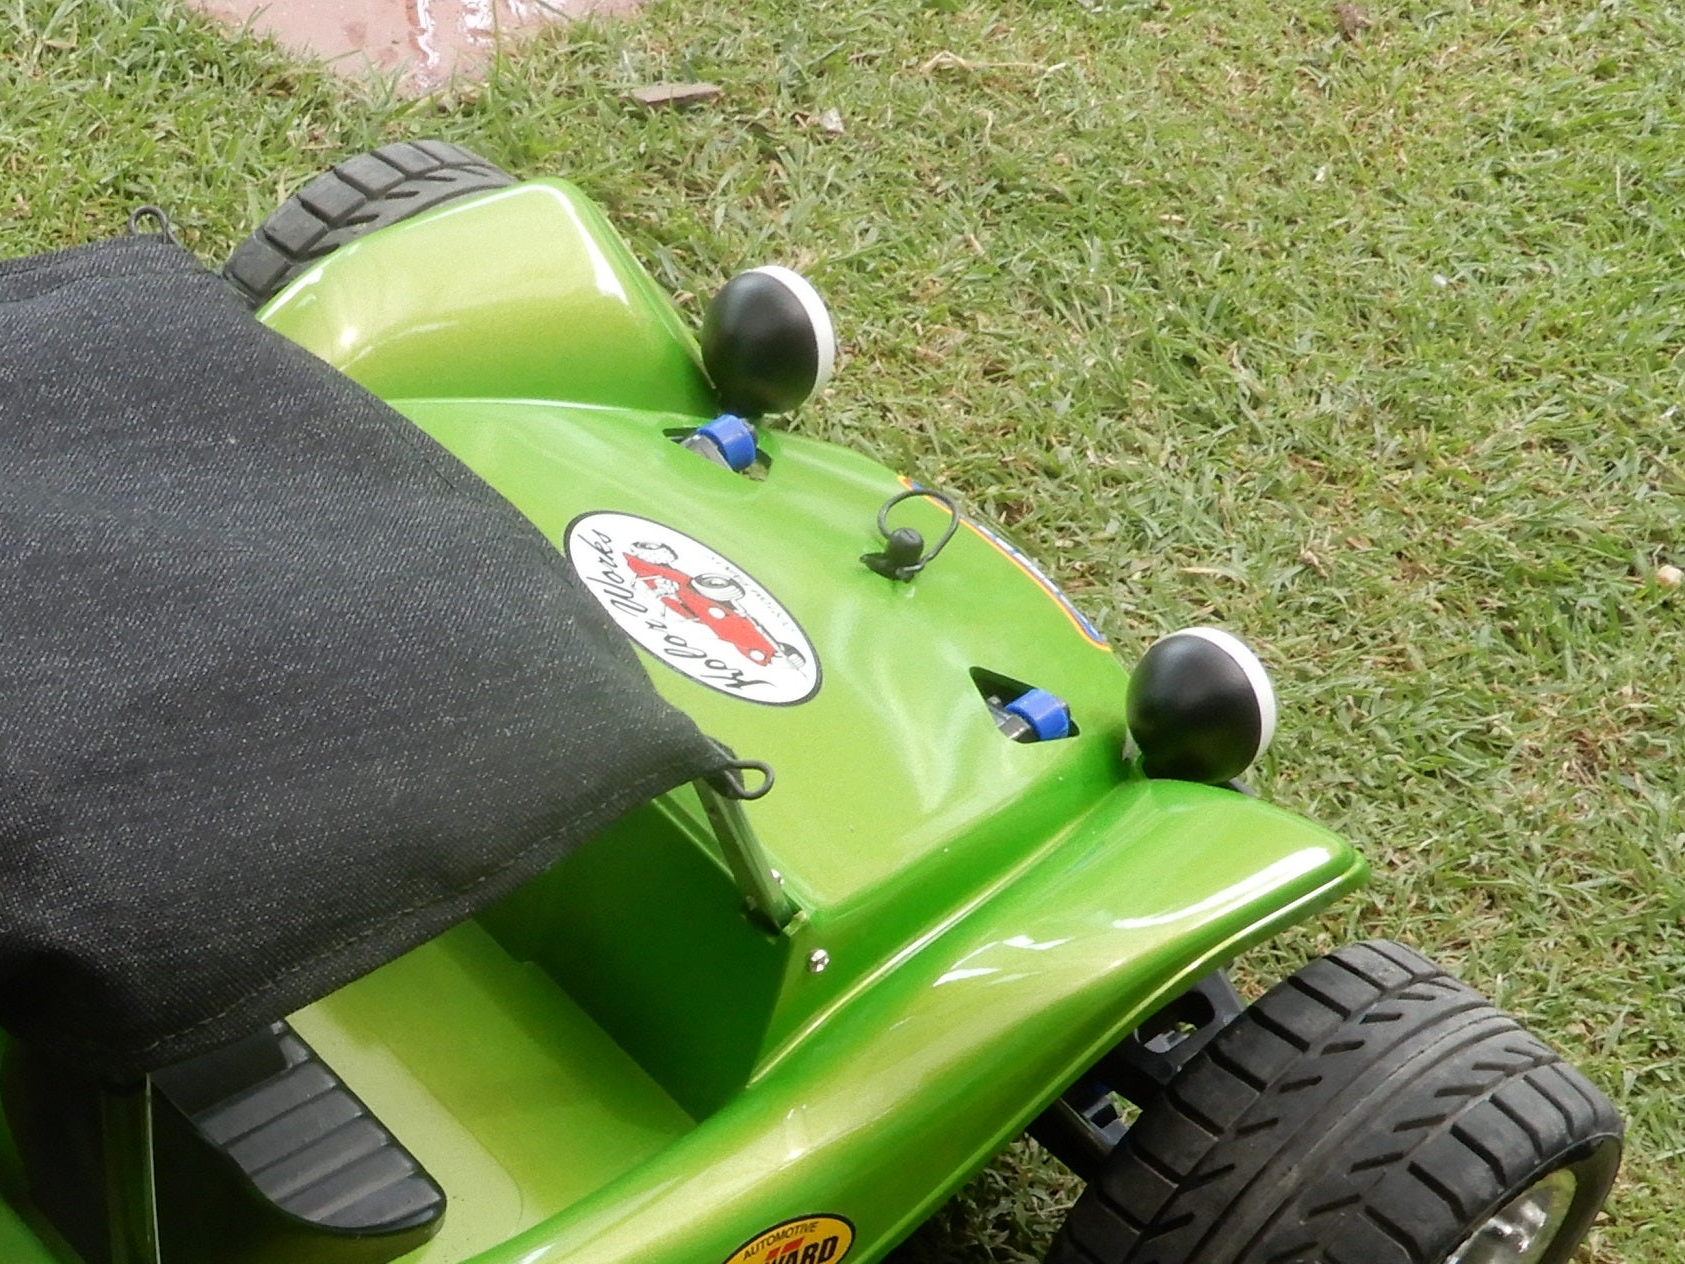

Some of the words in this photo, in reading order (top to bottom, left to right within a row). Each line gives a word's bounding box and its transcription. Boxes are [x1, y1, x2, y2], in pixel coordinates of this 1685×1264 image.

[577, 529, 648, 617] Works
[646, 618, 777, 689] Kolor
[743, 1221, 819, 1260] AUTOMOTIVE
